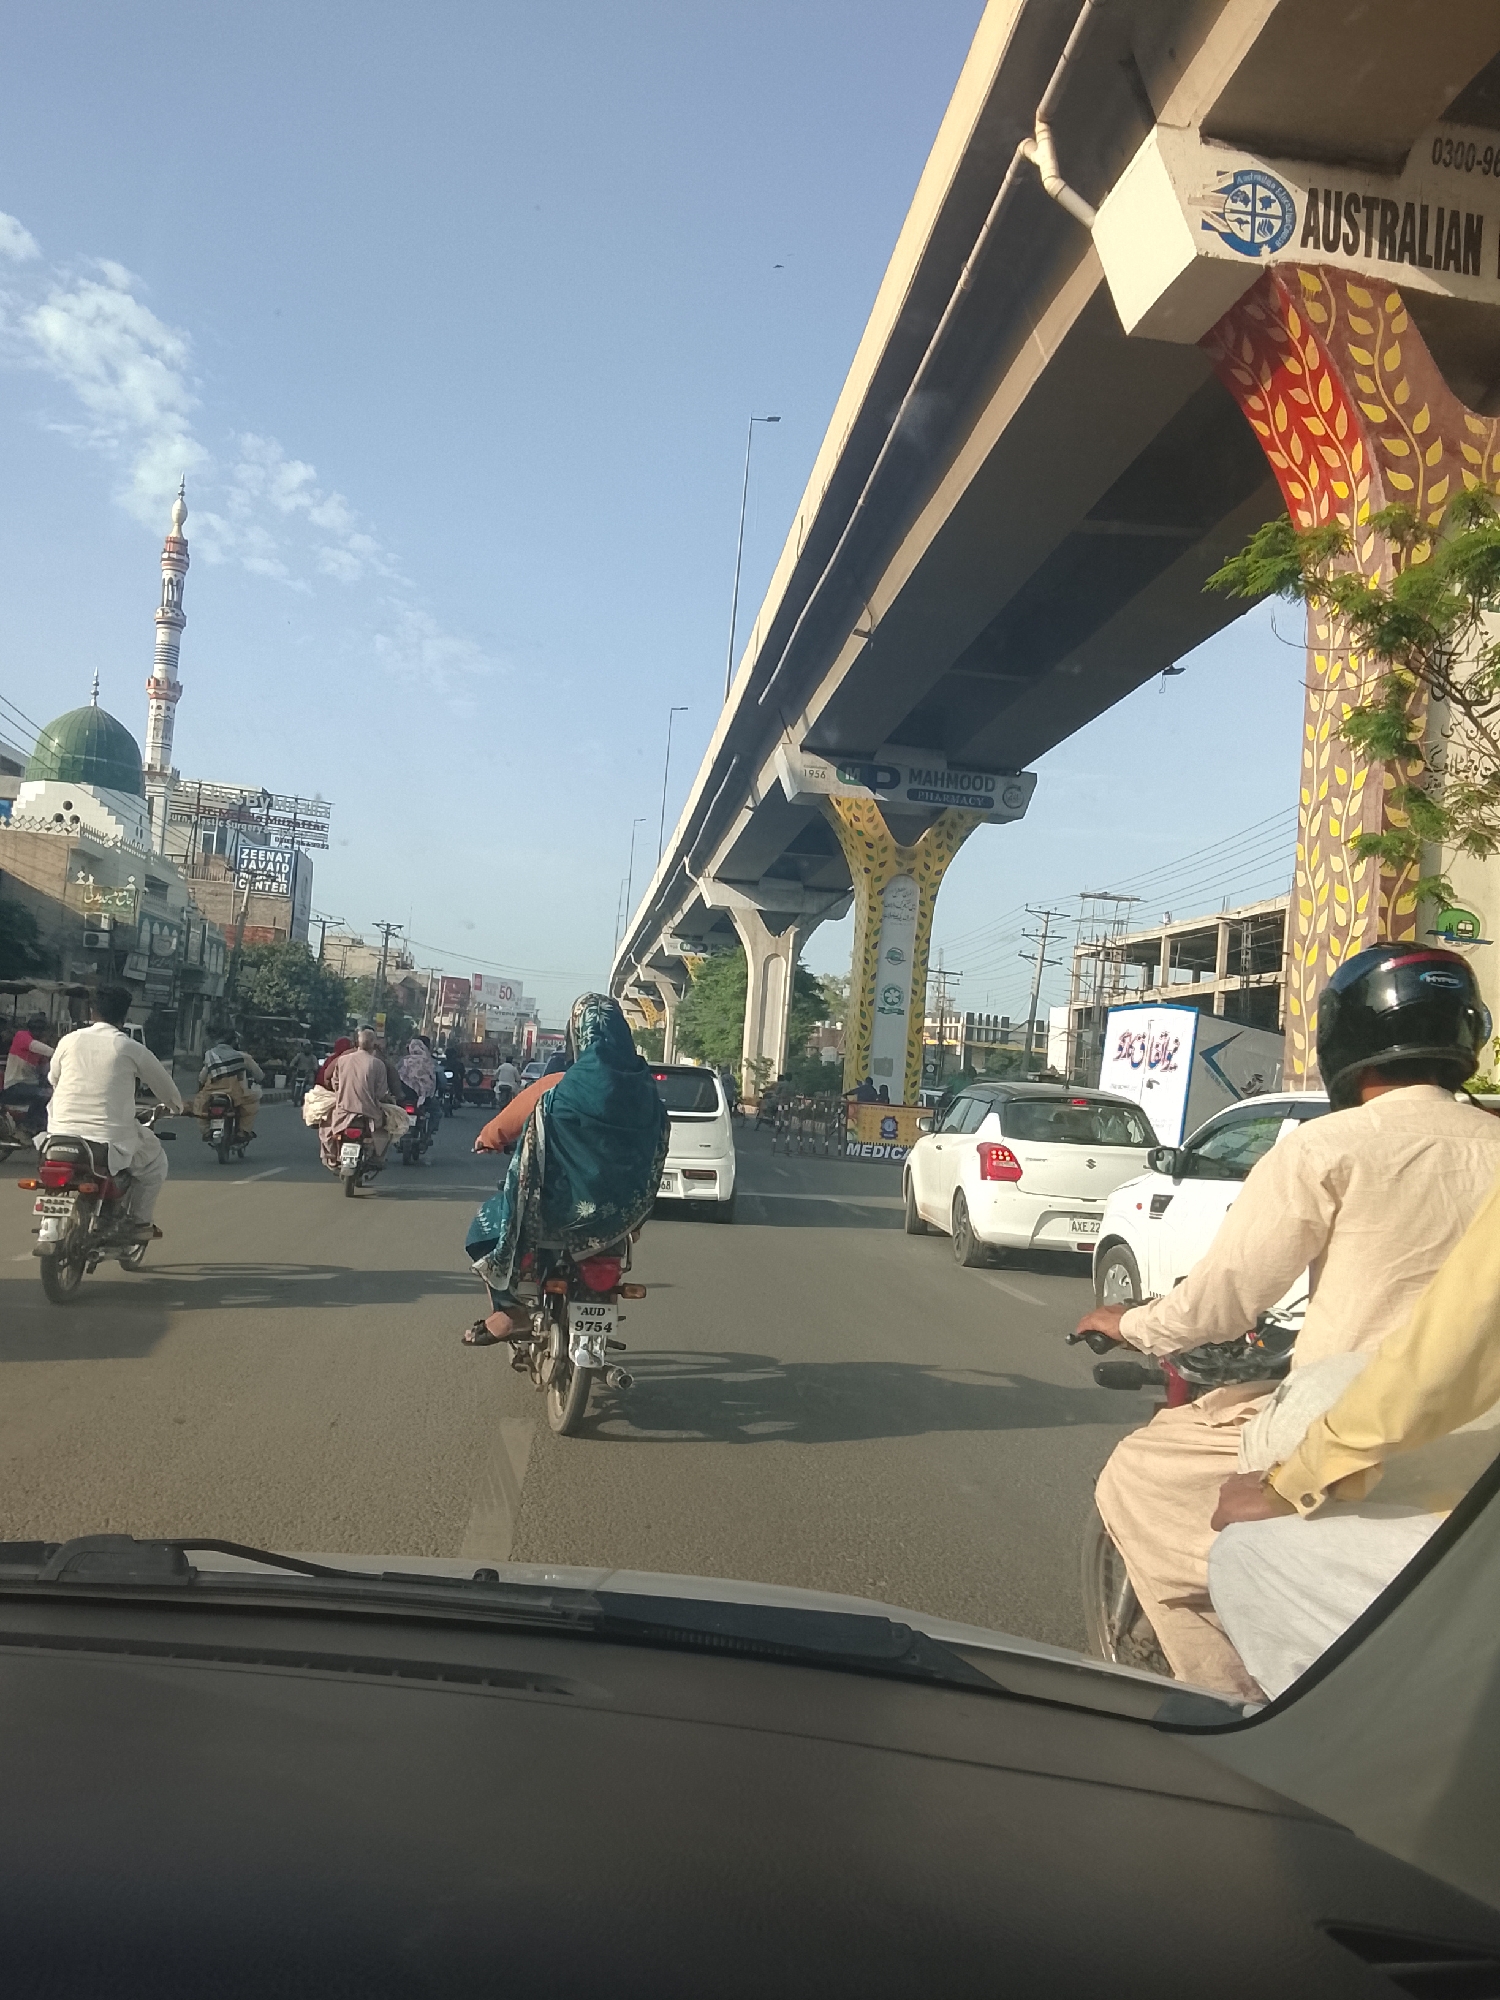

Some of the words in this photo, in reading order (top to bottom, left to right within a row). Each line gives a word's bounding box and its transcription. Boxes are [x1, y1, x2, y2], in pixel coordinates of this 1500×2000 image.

[1300, 187, 1484, 277] AUSTRALIAN
[803, 769, 826, 780] 1956
[908, 768, 996, 792] MAHMOOD
[917, 790, 985, 807] PHARMACY
[240, 848, 291, 863] ZEENAT
[240, 859, 290, 873] JAVAID
[238, 879, 288, 893] CNTER
[1071, 1220, 1088, 1232] AXE
[580, 1307, 606, 1317] AUD
[574, 1320, 612, 1333] 9754
